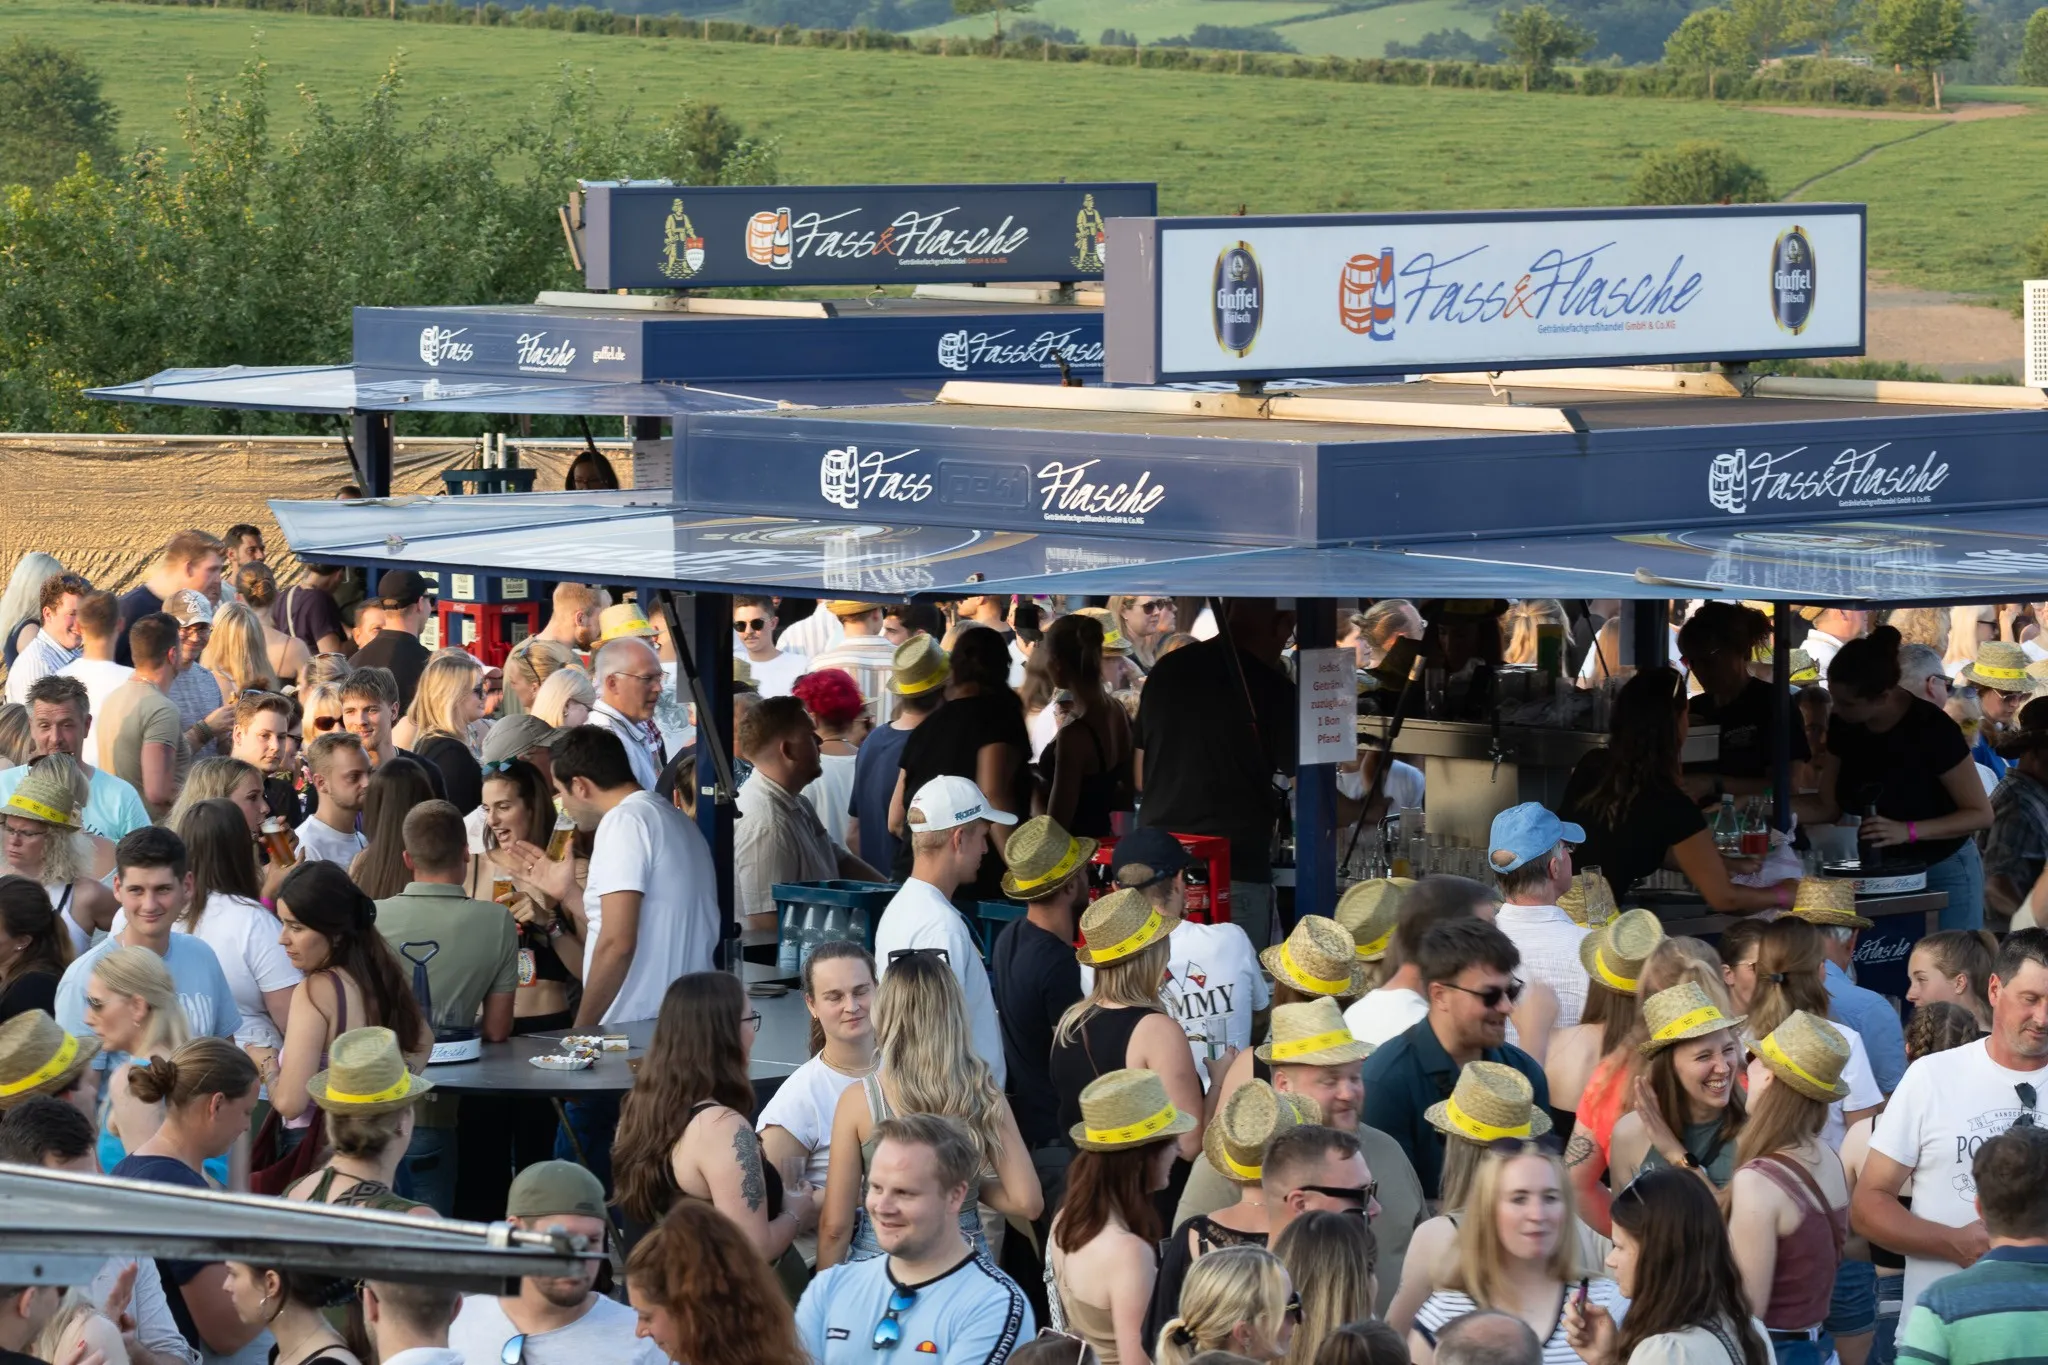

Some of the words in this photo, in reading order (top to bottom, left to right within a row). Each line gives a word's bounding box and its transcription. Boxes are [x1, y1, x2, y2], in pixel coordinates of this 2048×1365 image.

[1775, 269, 1811, 291] Gaffel
[1217, 287, 1258, 310] Gaffel
[1537, 321, 1624, 334] Getränkefachgroßhandel
[1625, 320, 1646, 331] GmbH
[1648, 320, 1654, 330] &
[439, 327, 474, 362] Fass
[516, 331, 577, 366] Flasche
[858, 448, 933, 502] Fass
[1037, 459, 1167, 514] Flasche
[1317, 732, 1341, 744] Pfand
[1177, 983, 1235, 1020] MMY
[987, 1333, 1015, 1365] ELLESS
